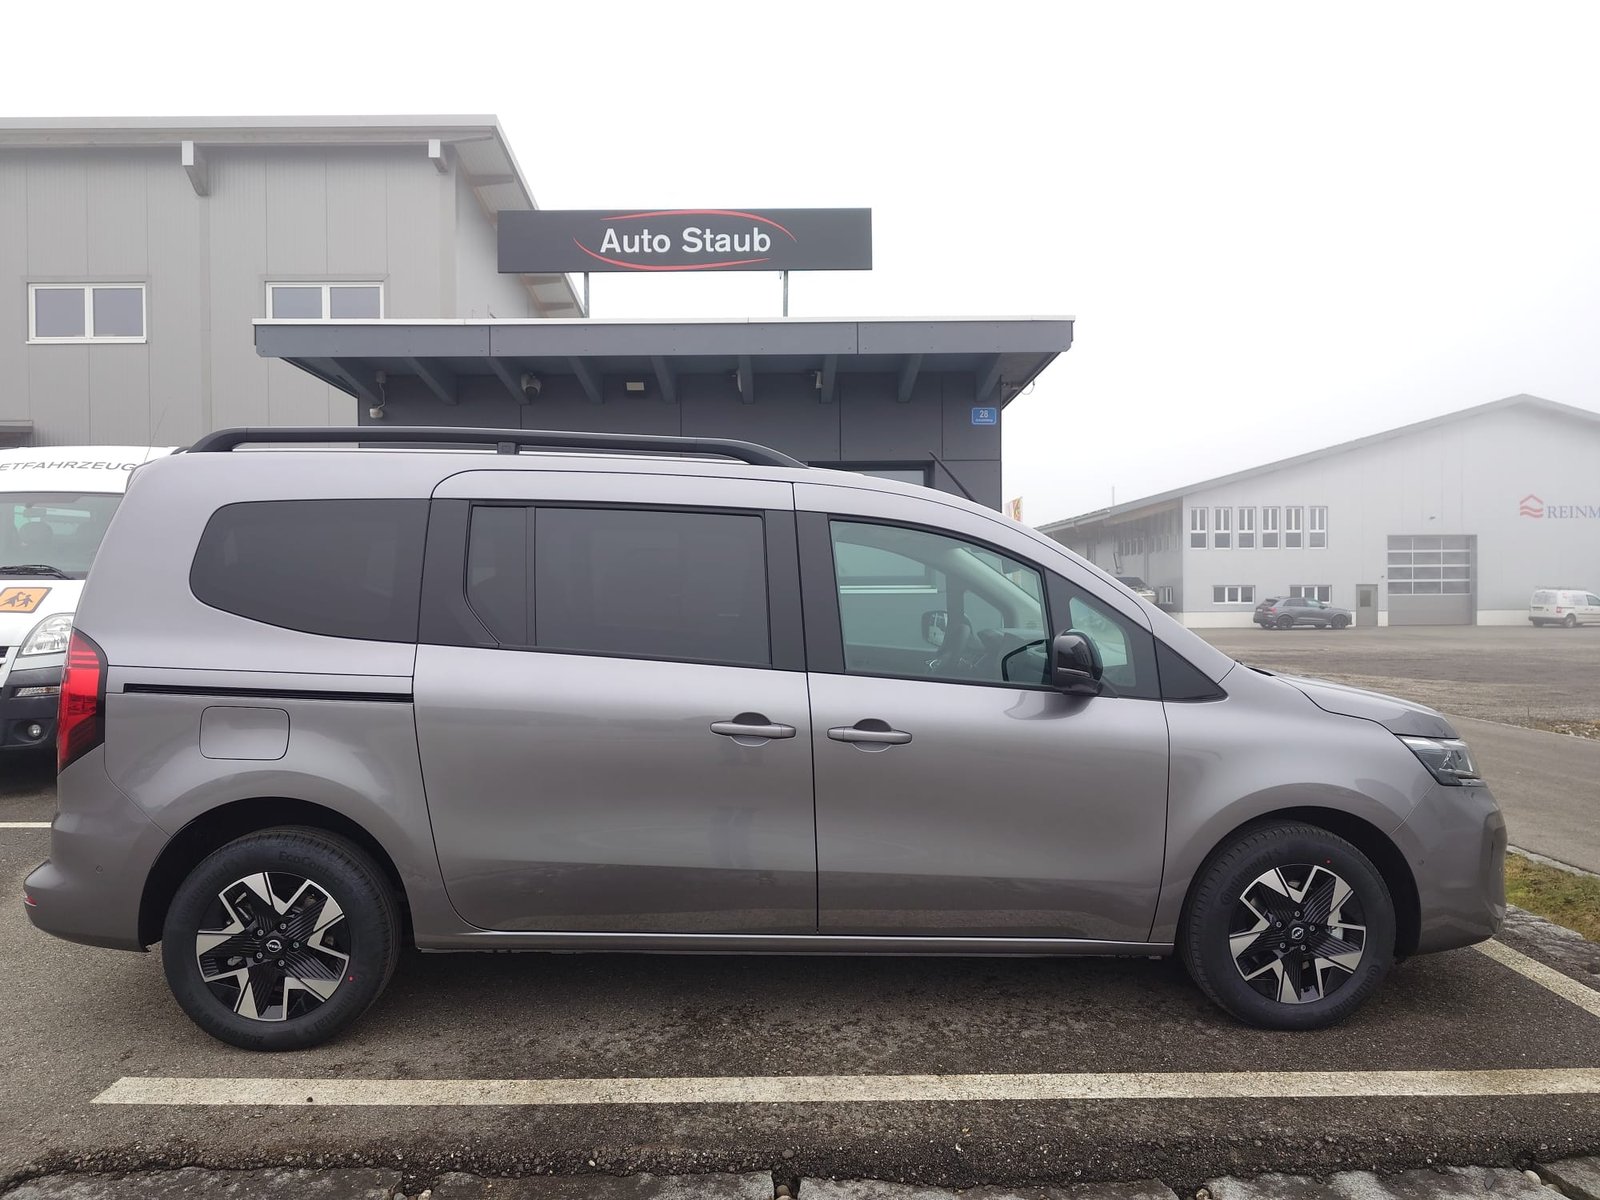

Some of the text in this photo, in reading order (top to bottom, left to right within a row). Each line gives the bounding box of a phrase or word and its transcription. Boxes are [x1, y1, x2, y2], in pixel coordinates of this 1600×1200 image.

[600, 227, 771, 253] Auto Staub
[979, 409, 989, 418] 28
[0, 461, 137, 471] ETFAHRZEUG
